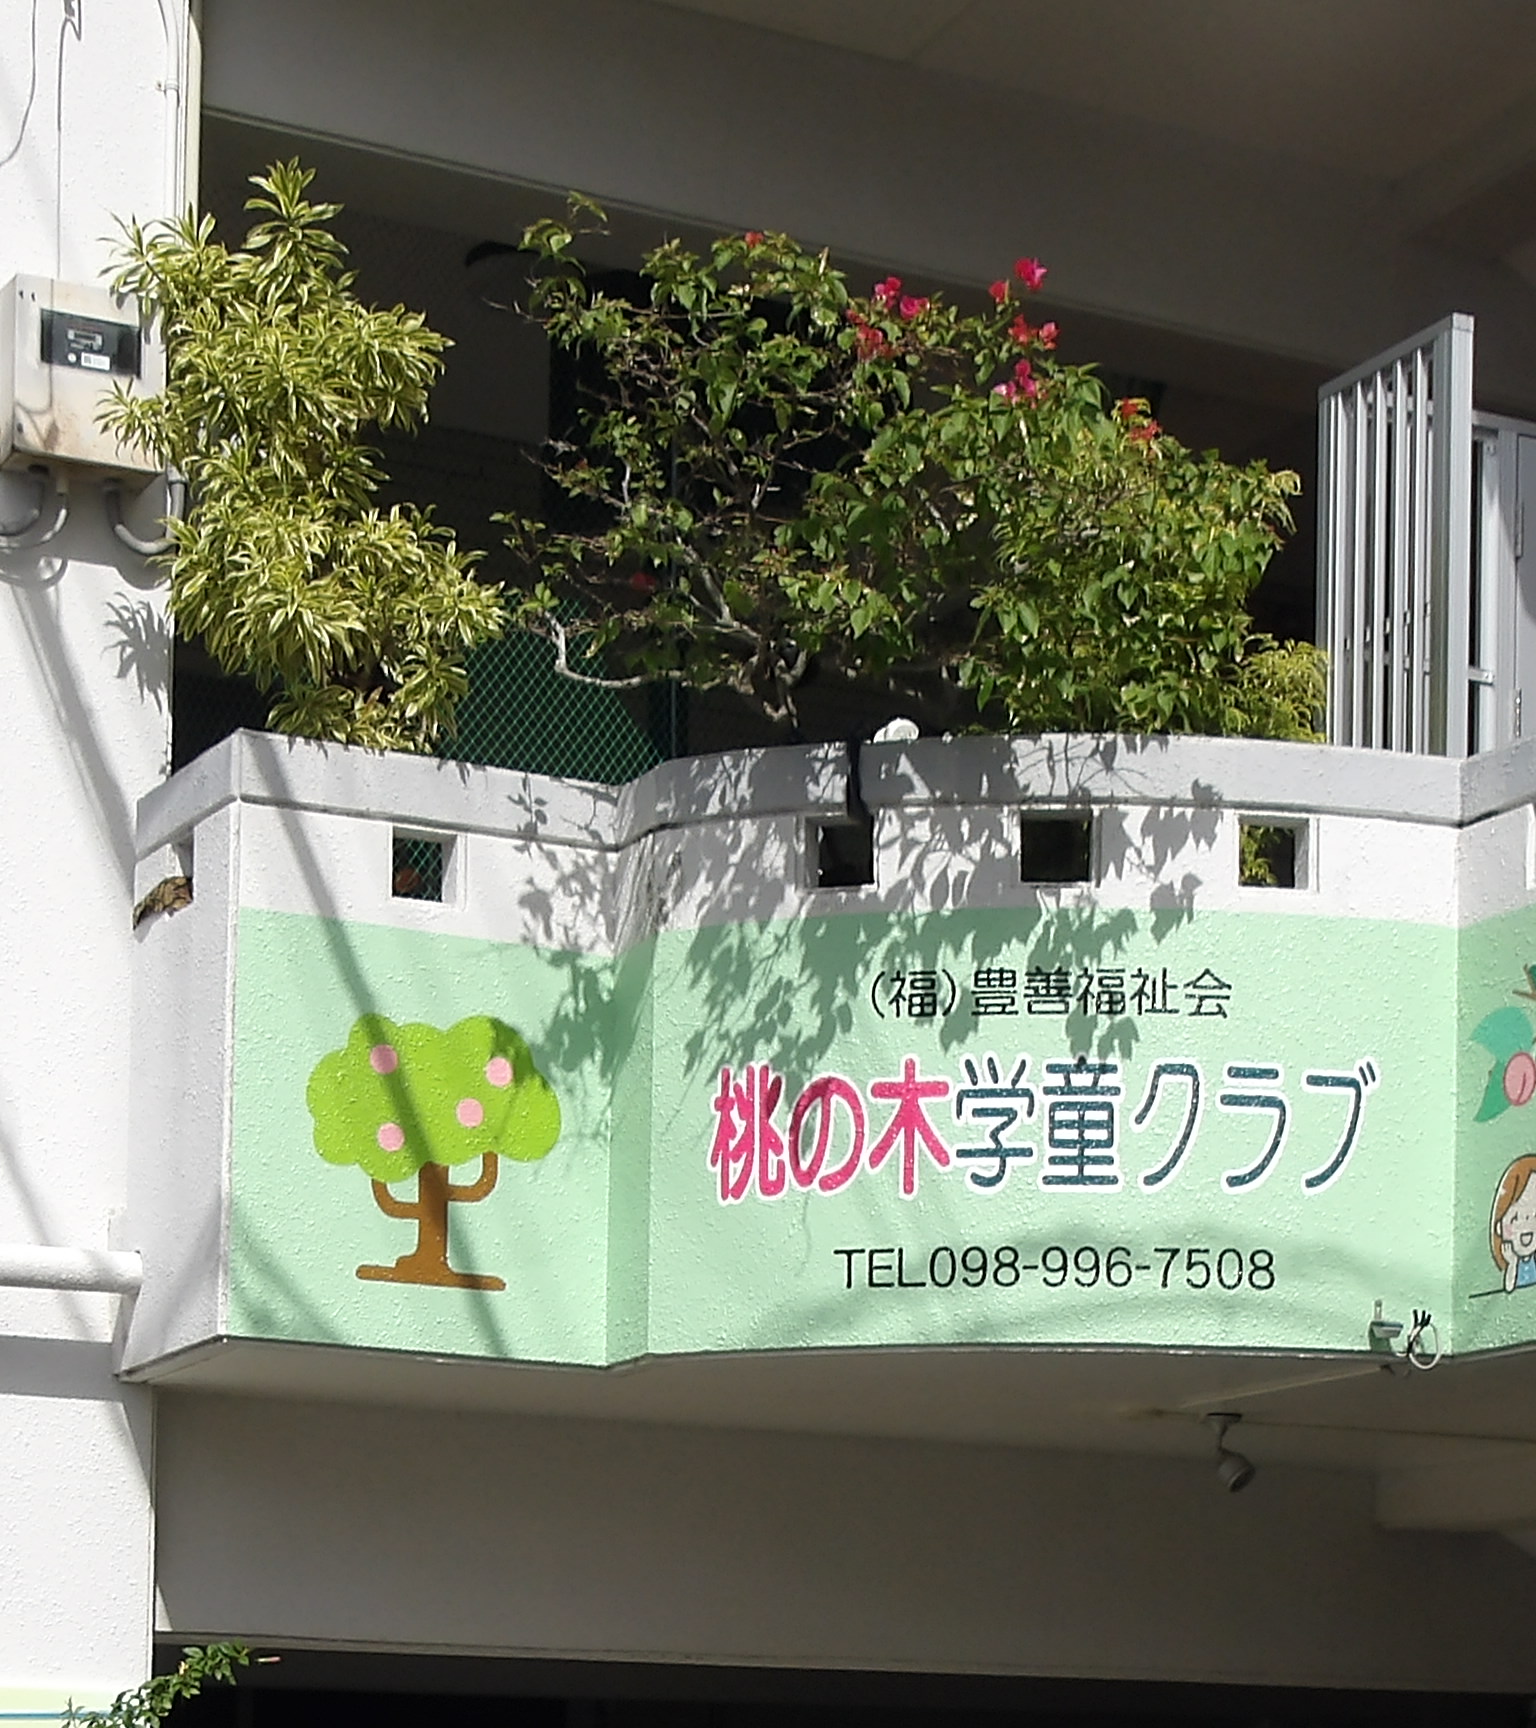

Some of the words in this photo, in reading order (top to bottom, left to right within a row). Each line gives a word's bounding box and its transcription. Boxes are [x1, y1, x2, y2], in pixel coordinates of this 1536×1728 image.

[711, 1057, 1376, 1200] 桃の木学童クラブ
[834, 1246, 1276, 1292] TEL098-996-7508
